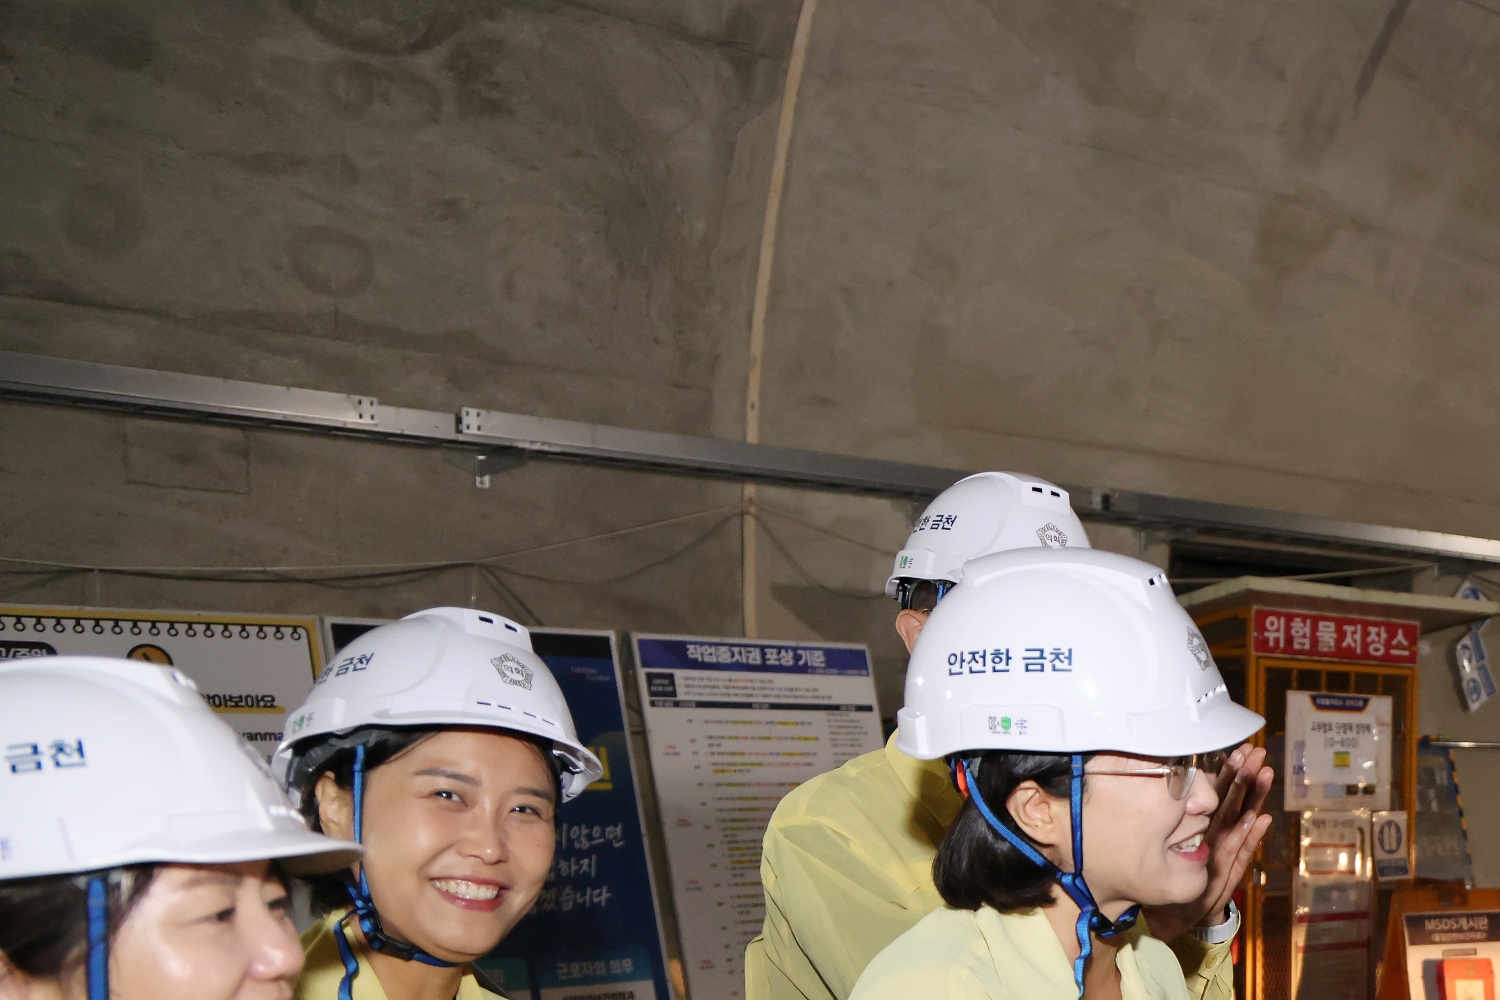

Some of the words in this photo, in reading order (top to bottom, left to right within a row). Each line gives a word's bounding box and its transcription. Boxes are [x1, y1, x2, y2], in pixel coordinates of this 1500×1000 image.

[930, 514, 958, 531] 금천
[334, 652, 375, 677] 금천
[686, 644, 762, 665] 작업중지권
[764, 648, 795, 666] 포상
[797, 649, 826, 667] 기준
[947, 648, 1013, 676] 안전한
[1021, 647, 1073, 673] 금천
[242, 732, 284, 741] anma
[3, 738, 87, 774] 금천
